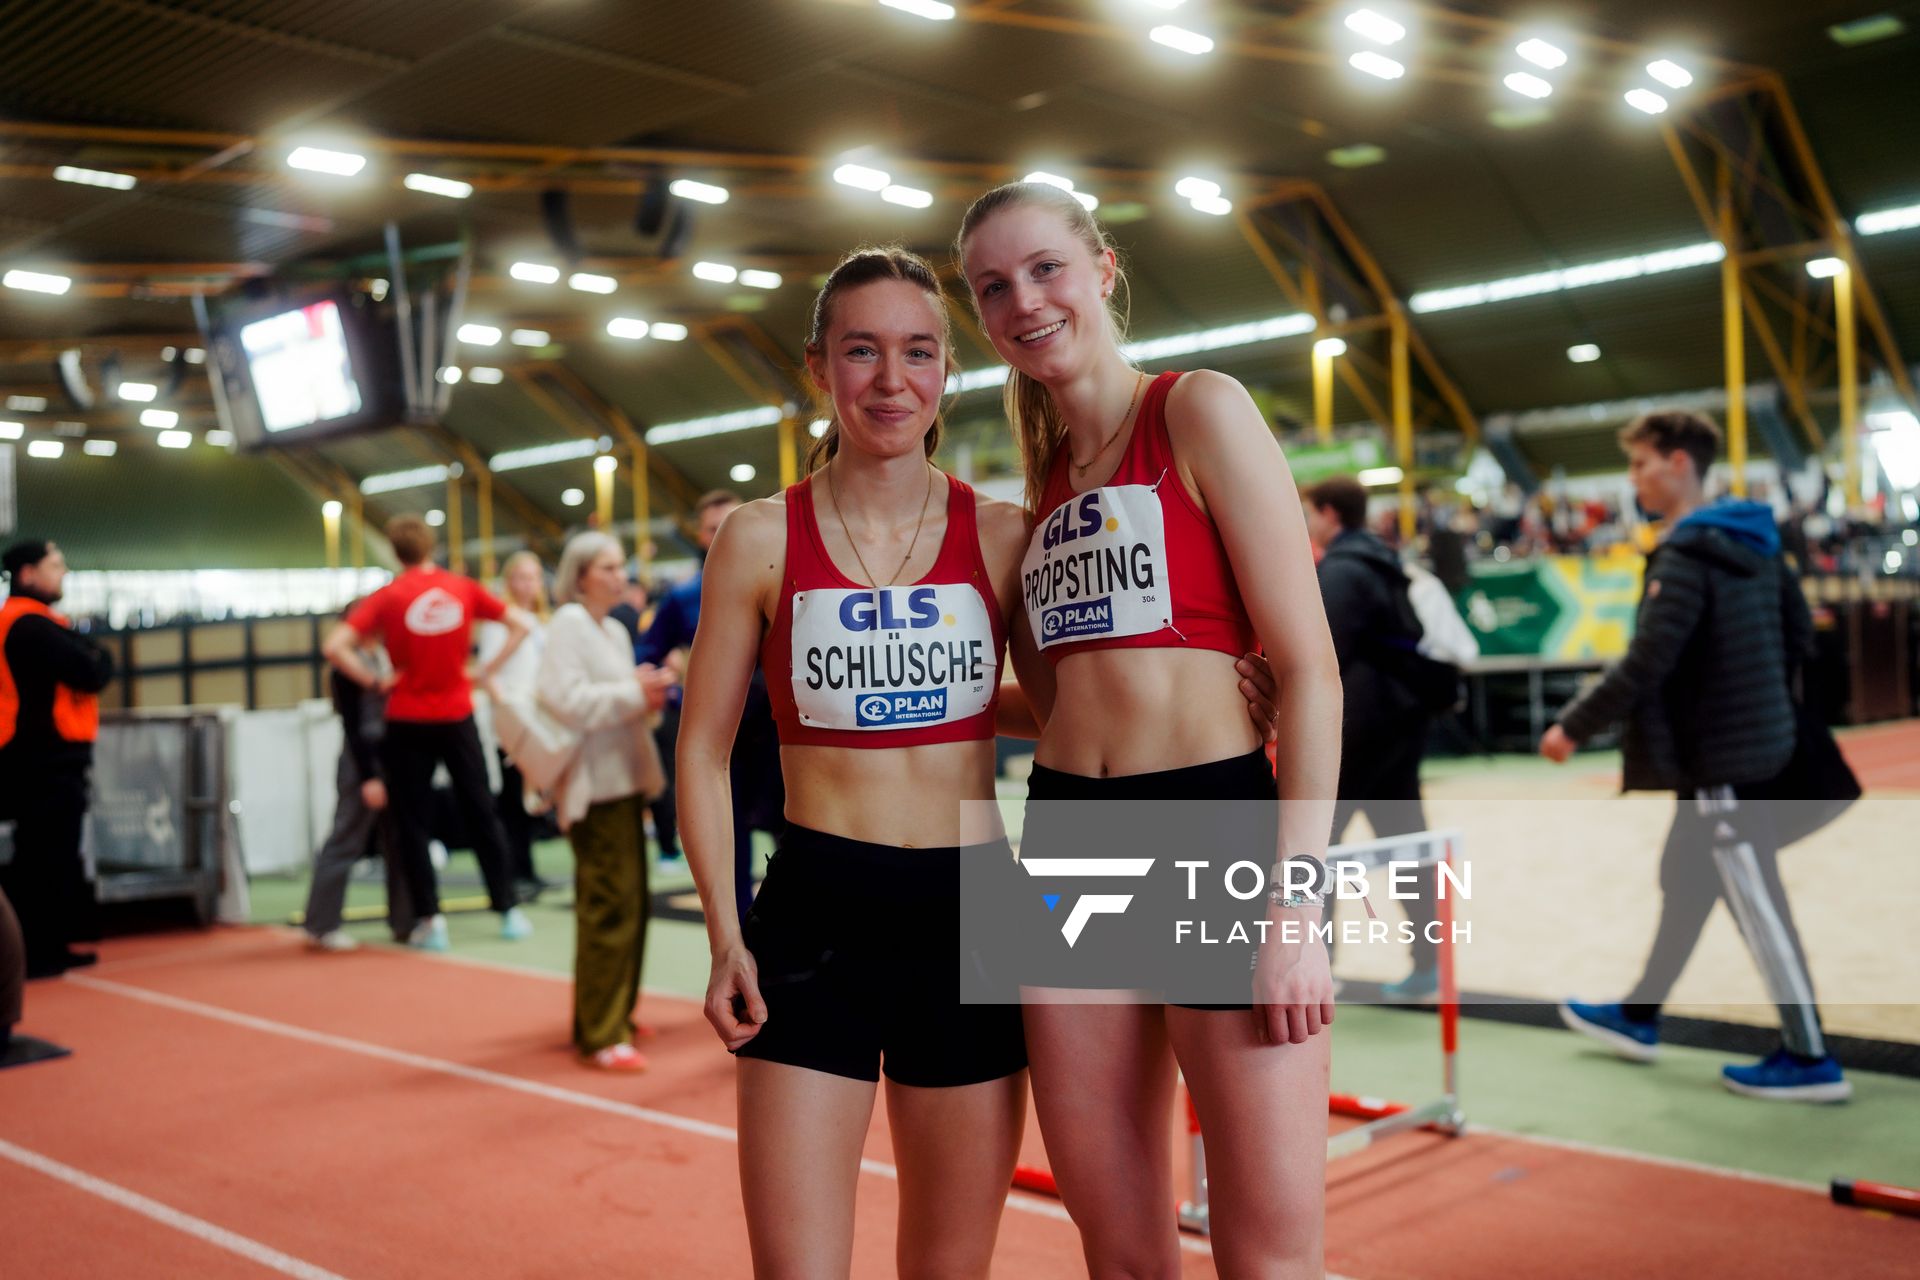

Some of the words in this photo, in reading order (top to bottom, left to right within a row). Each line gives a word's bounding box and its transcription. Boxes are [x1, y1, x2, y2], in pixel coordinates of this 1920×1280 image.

[1024, 542, 1155, 612] PRÖPSTING
[1142, 595, 1156, 603] 306
[1065, 605, 1109, 624] PLAN
[1065, 622, 1110, 632] INTERNATIONAL
[806, 632, 984, 690] SCHLÜSCHE
[972, 685, 984, 693] 307
[894, 695, 944, 712] PLAN
[895, 710, 943, 720] INTERNATIONAL
